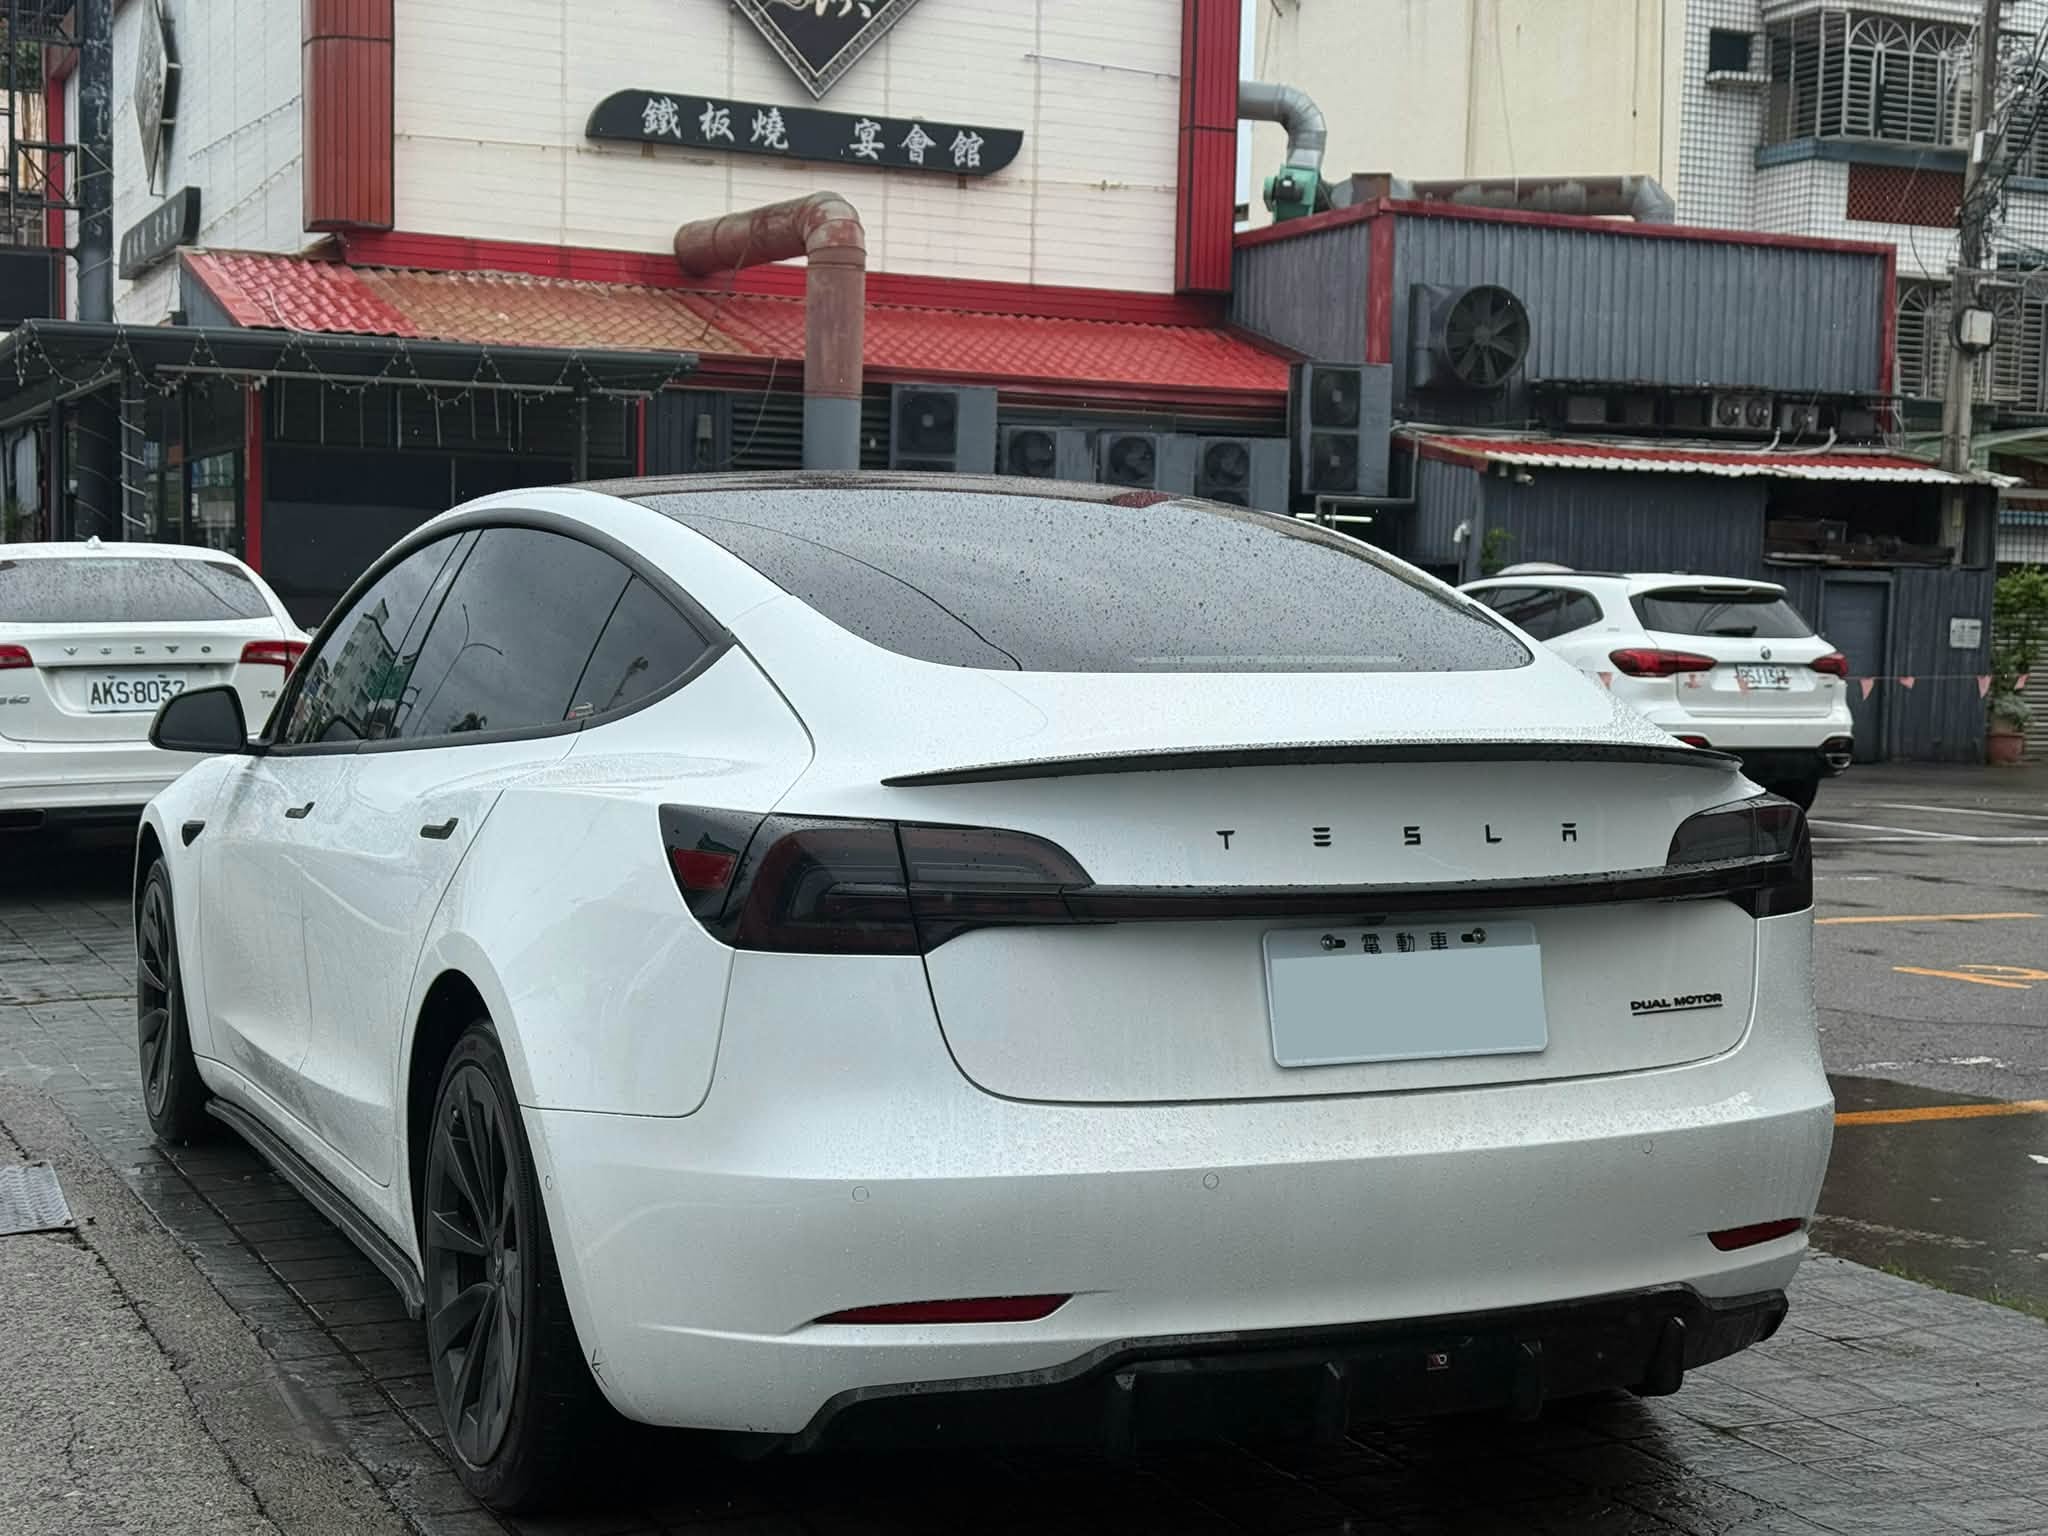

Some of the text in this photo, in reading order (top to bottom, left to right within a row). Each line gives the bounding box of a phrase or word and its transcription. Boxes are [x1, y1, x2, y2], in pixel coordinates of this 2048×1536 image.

[641, 97, 986, 167] 鐵板燒 宴會館
[1216, 823, 1578, 851] TESLA
[1361, 931, 1449, 954] 電動車
[1630, 993, 1723, 1011] DUAL MOTOR
